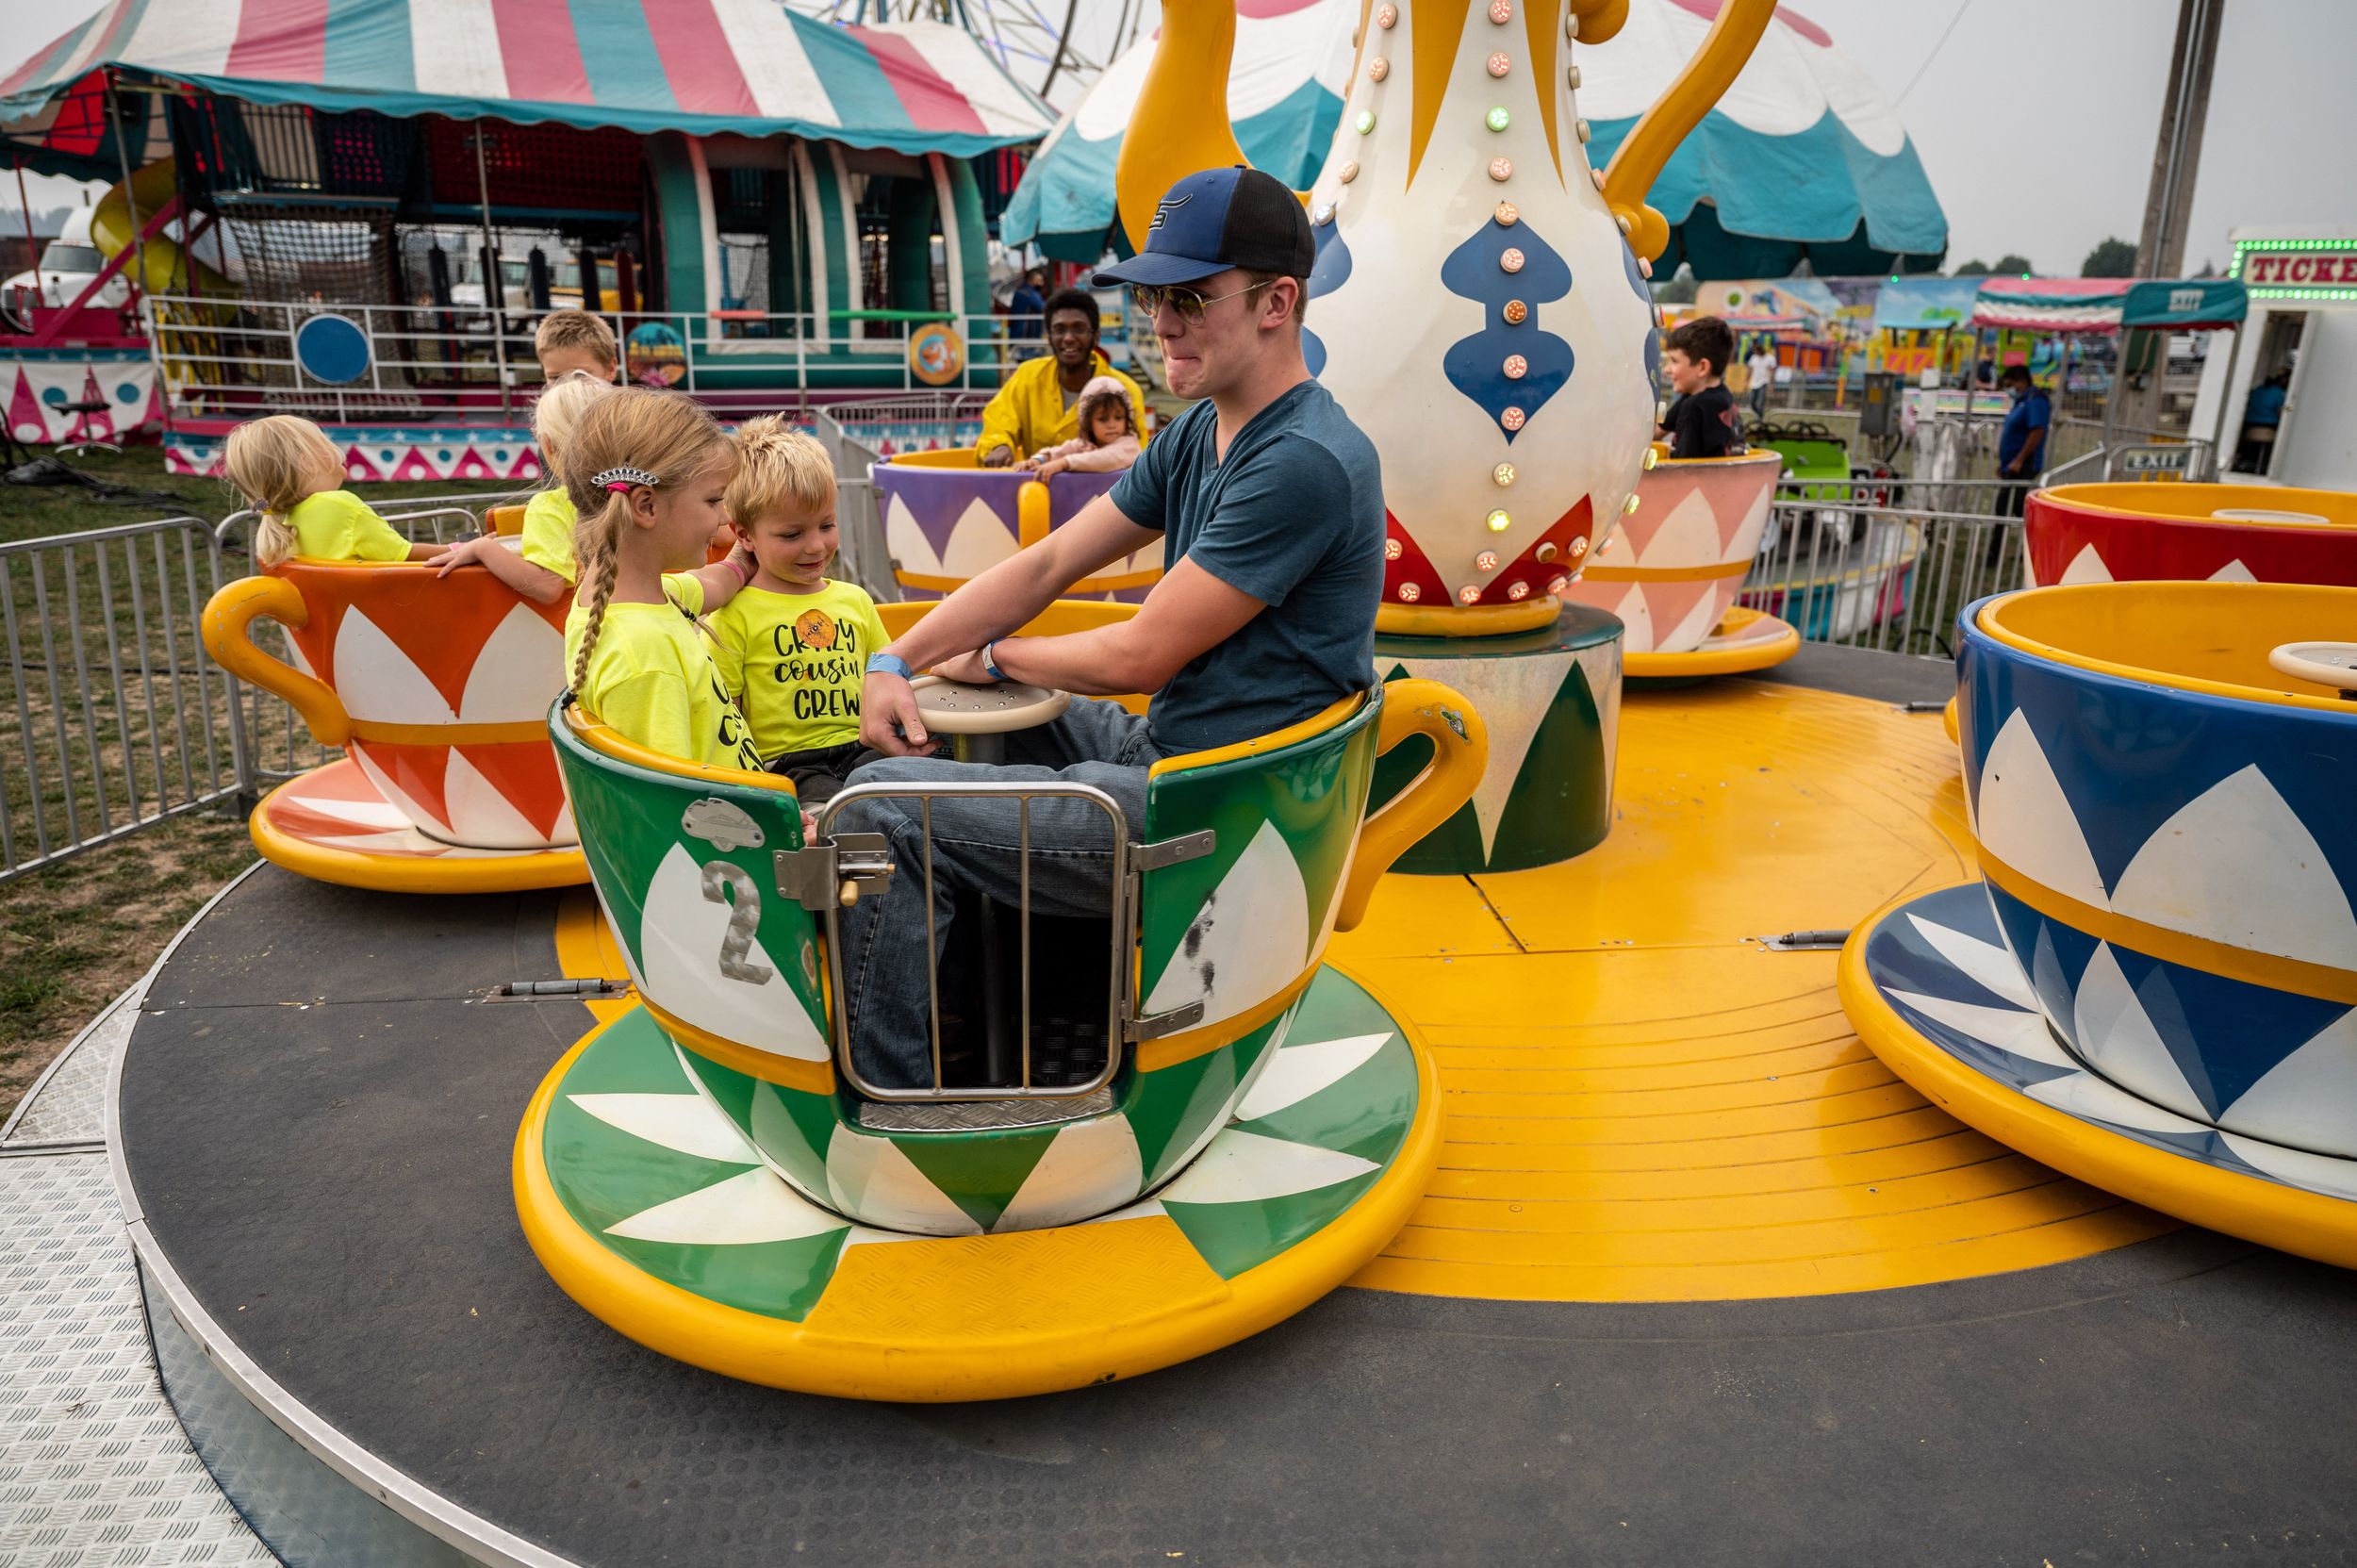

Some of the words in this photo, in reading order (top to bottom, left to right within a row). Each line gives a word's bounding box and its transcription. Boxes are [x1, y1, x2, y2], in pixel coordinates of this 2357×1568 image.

[2133, 454, 2178, 468] EXIT
[774, 619, 855, 656] CRZY
[774, 656, 861, 685] cousin
[794, 688, 861, 719] CREW
[701, 859, 773, 986] 2
